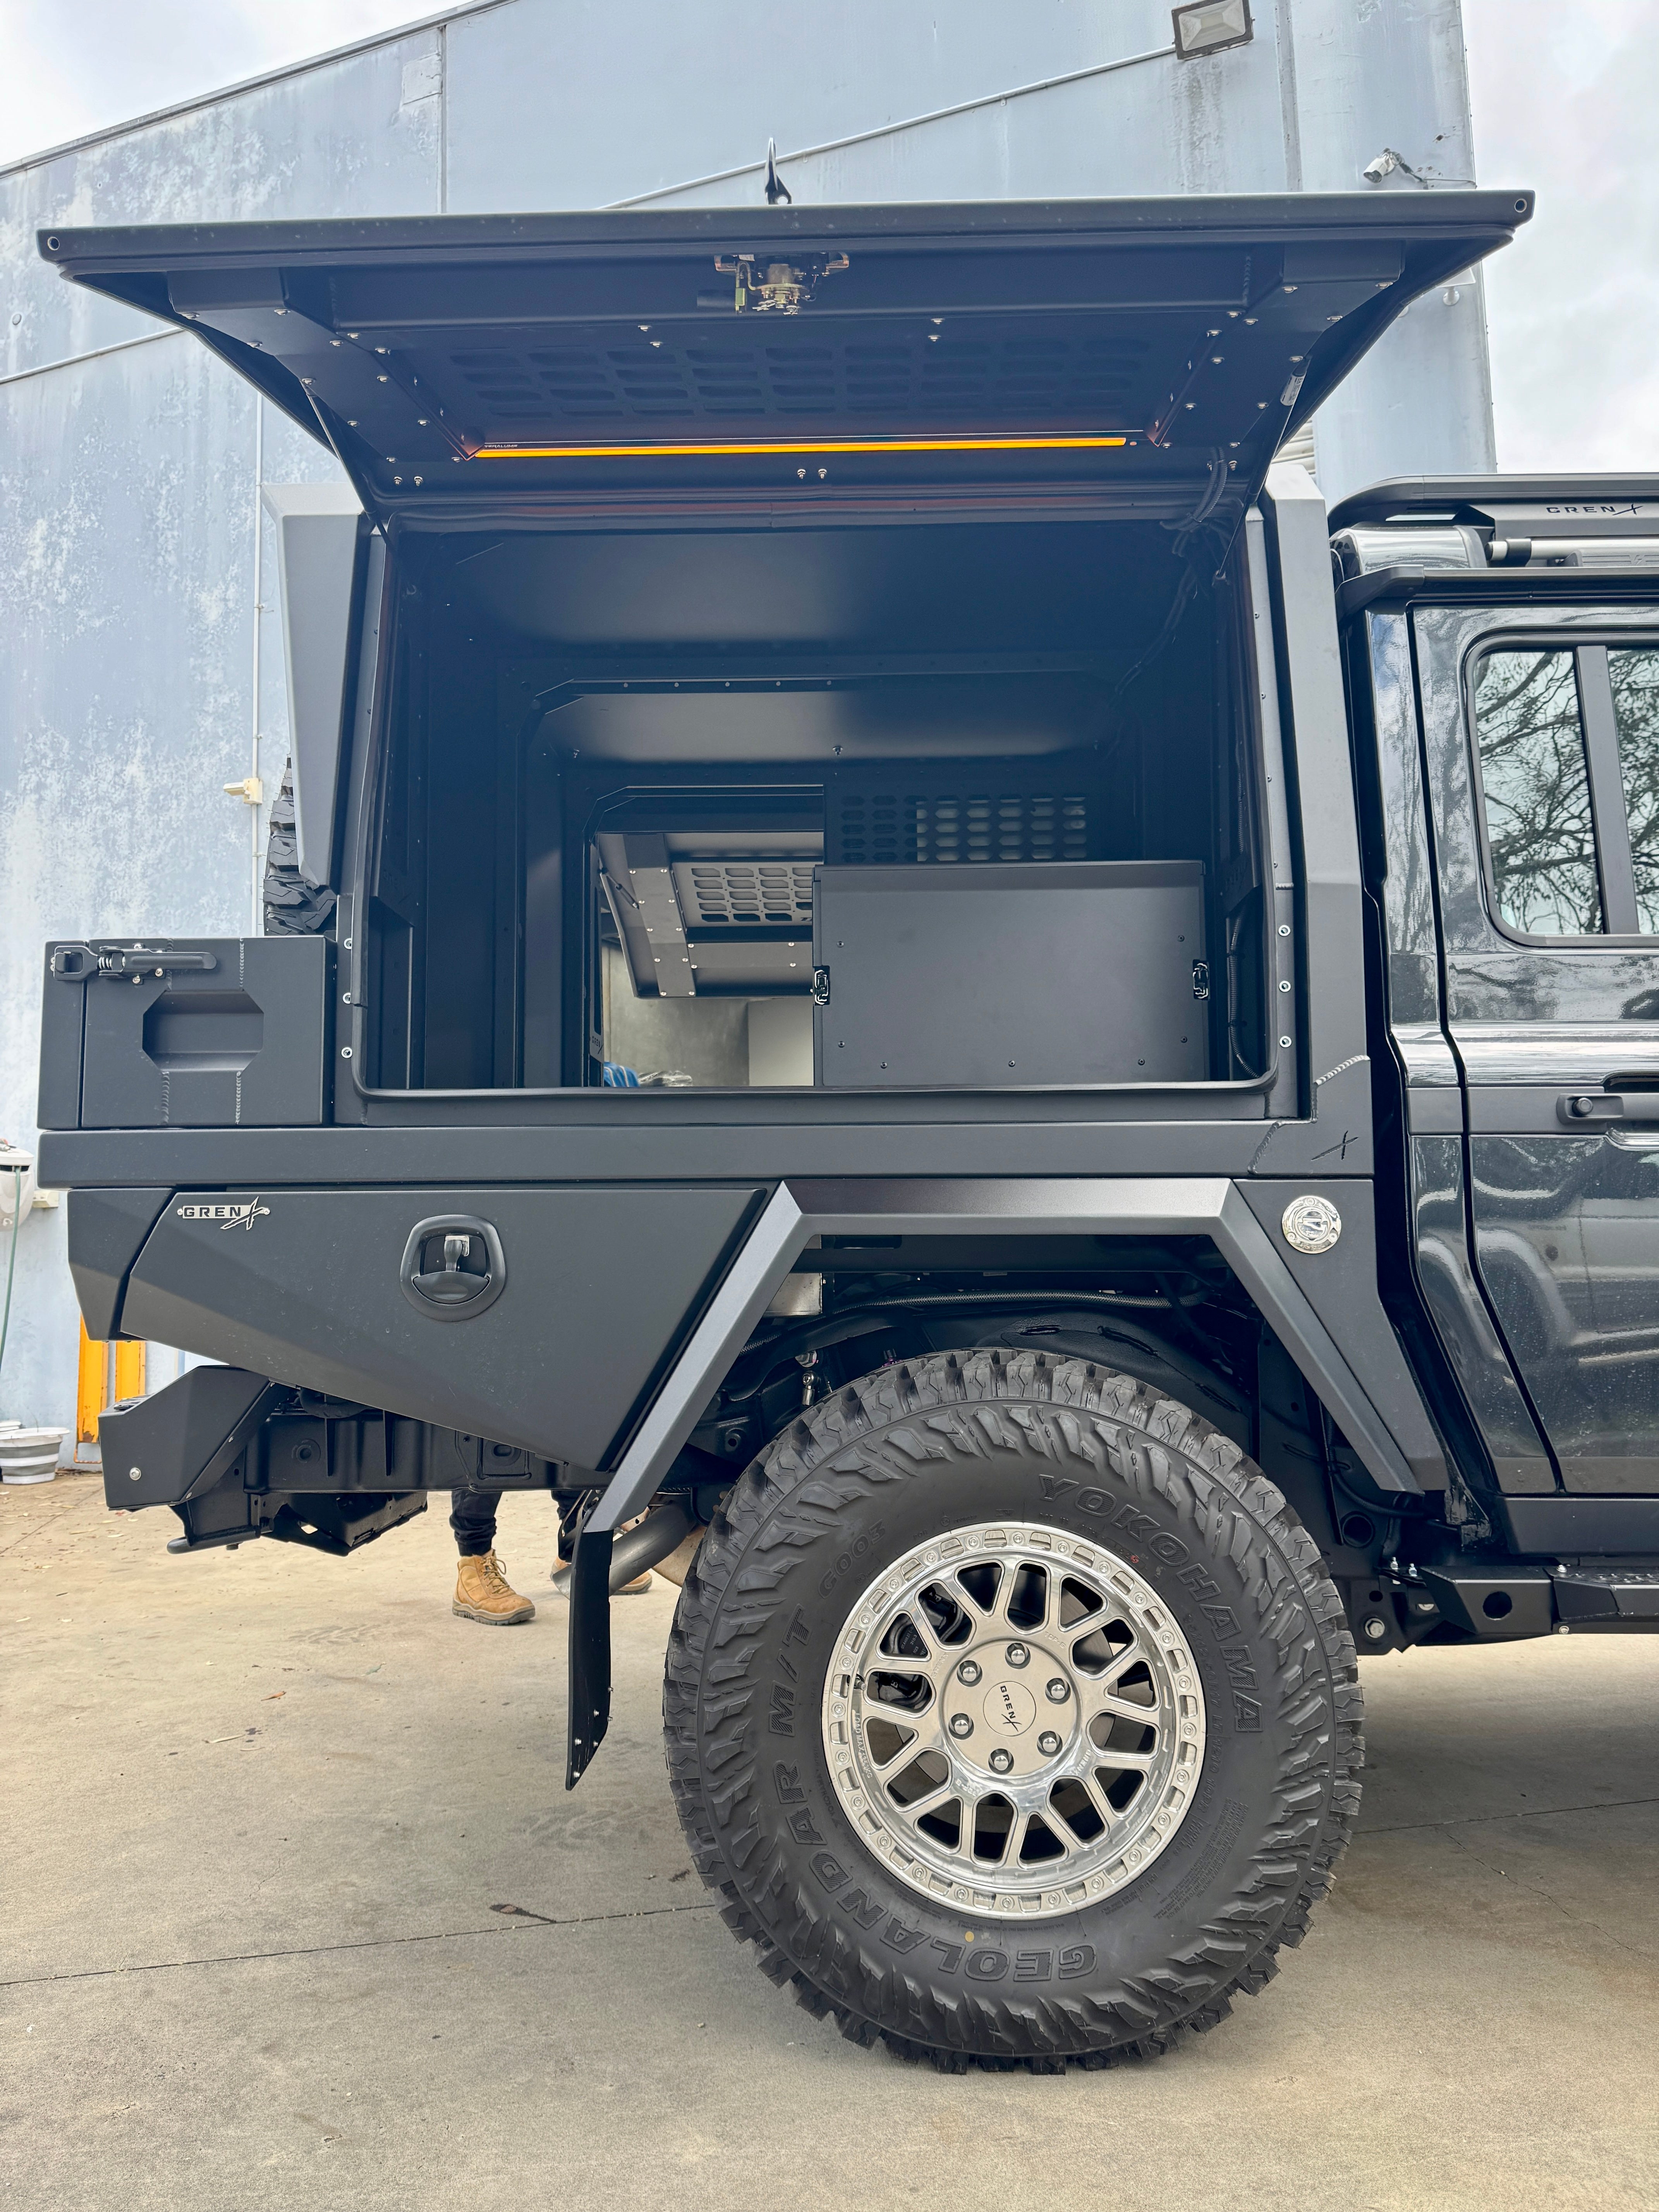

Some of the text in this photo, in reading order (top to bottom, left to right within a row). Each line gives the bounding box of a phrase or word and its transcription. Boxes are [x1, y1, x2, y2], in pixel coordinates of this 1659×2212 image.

[818, 1522, 888, 1600] G003
[1037, 1475, 1262, 1731] YOKOHAMA
[769, 1602, 815, 1736] M/T
[817, 1776, 835, 1816] YOKOHAMA
[856, 1735, 865, 1753] MAX
[773, 1760, 1099, 1982] GEOLANDAR
